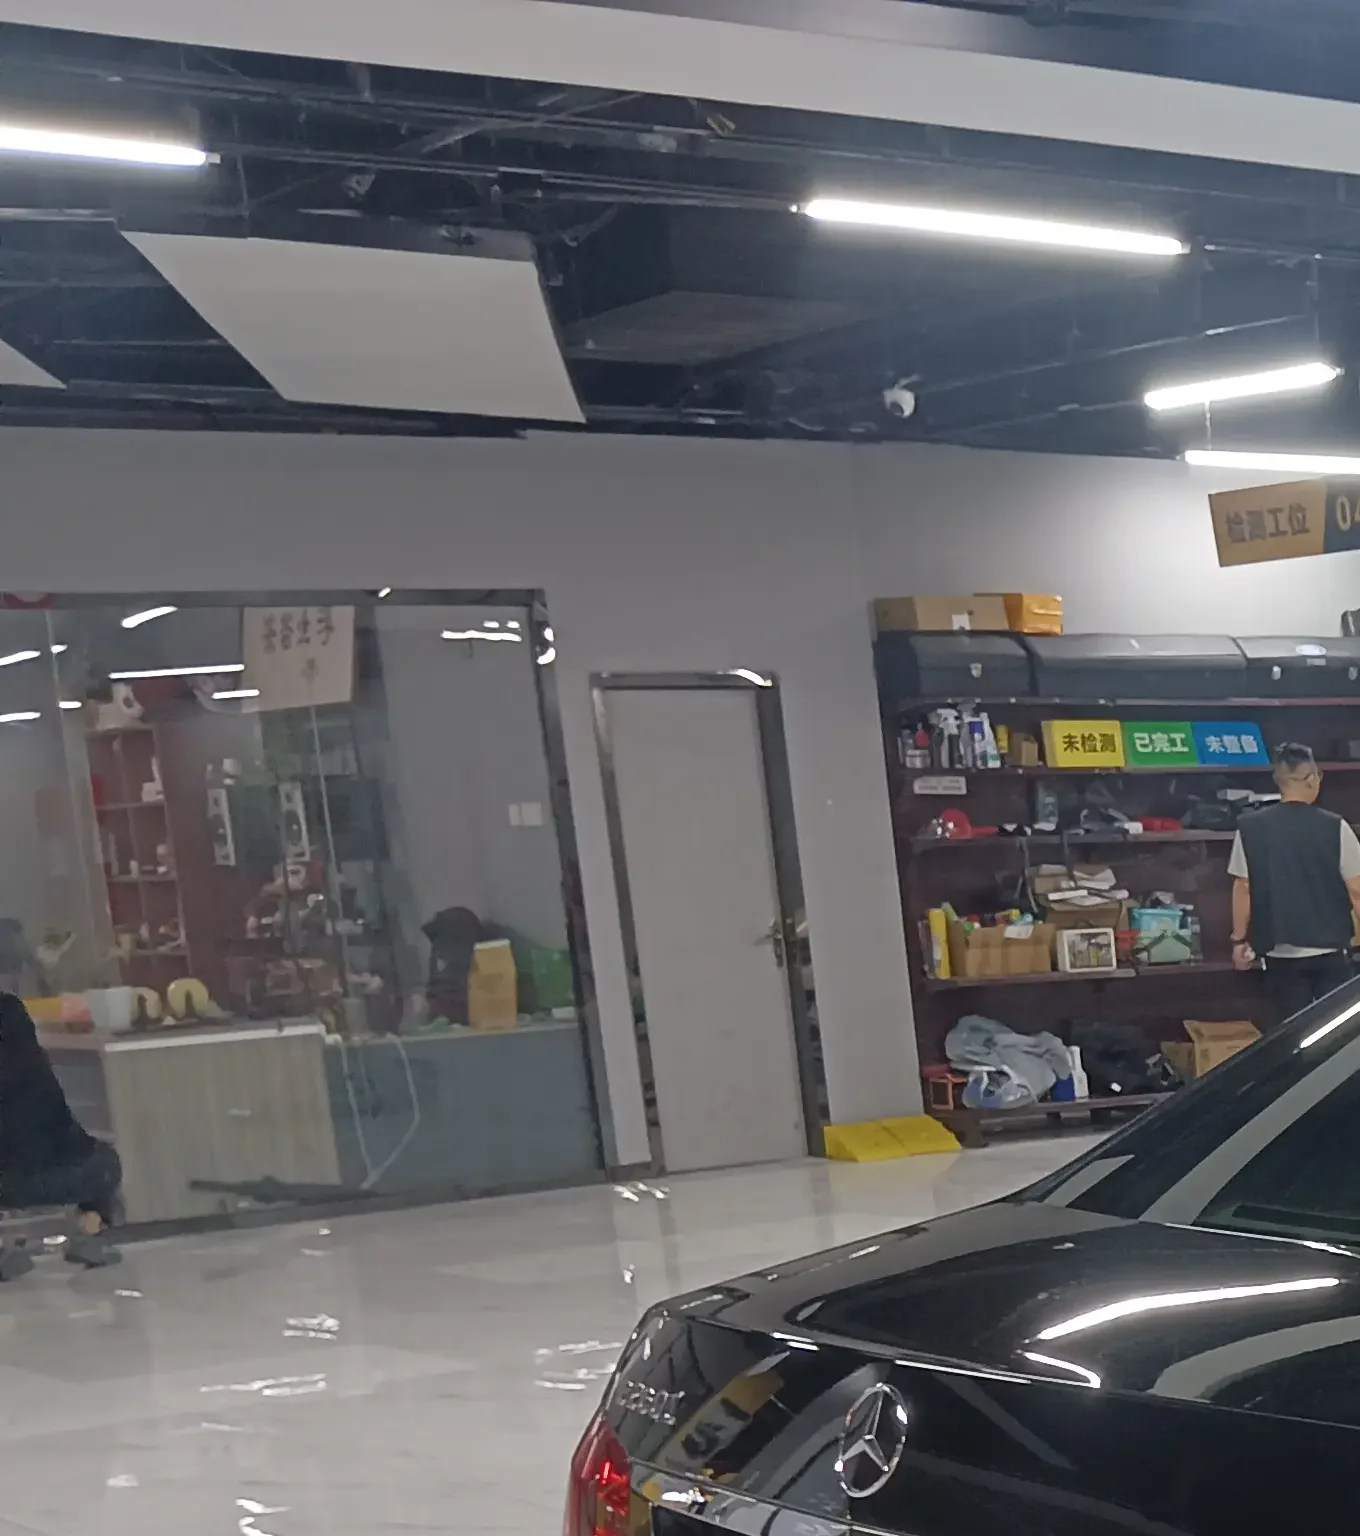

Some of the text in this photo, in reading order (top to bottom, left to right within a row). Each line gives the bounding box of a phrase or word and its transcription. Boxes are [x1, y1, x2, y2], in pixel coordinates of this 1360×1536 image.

[1062, 732, 1116, 754] 未检测
[1133, 732, 1189, 754] 已完工
